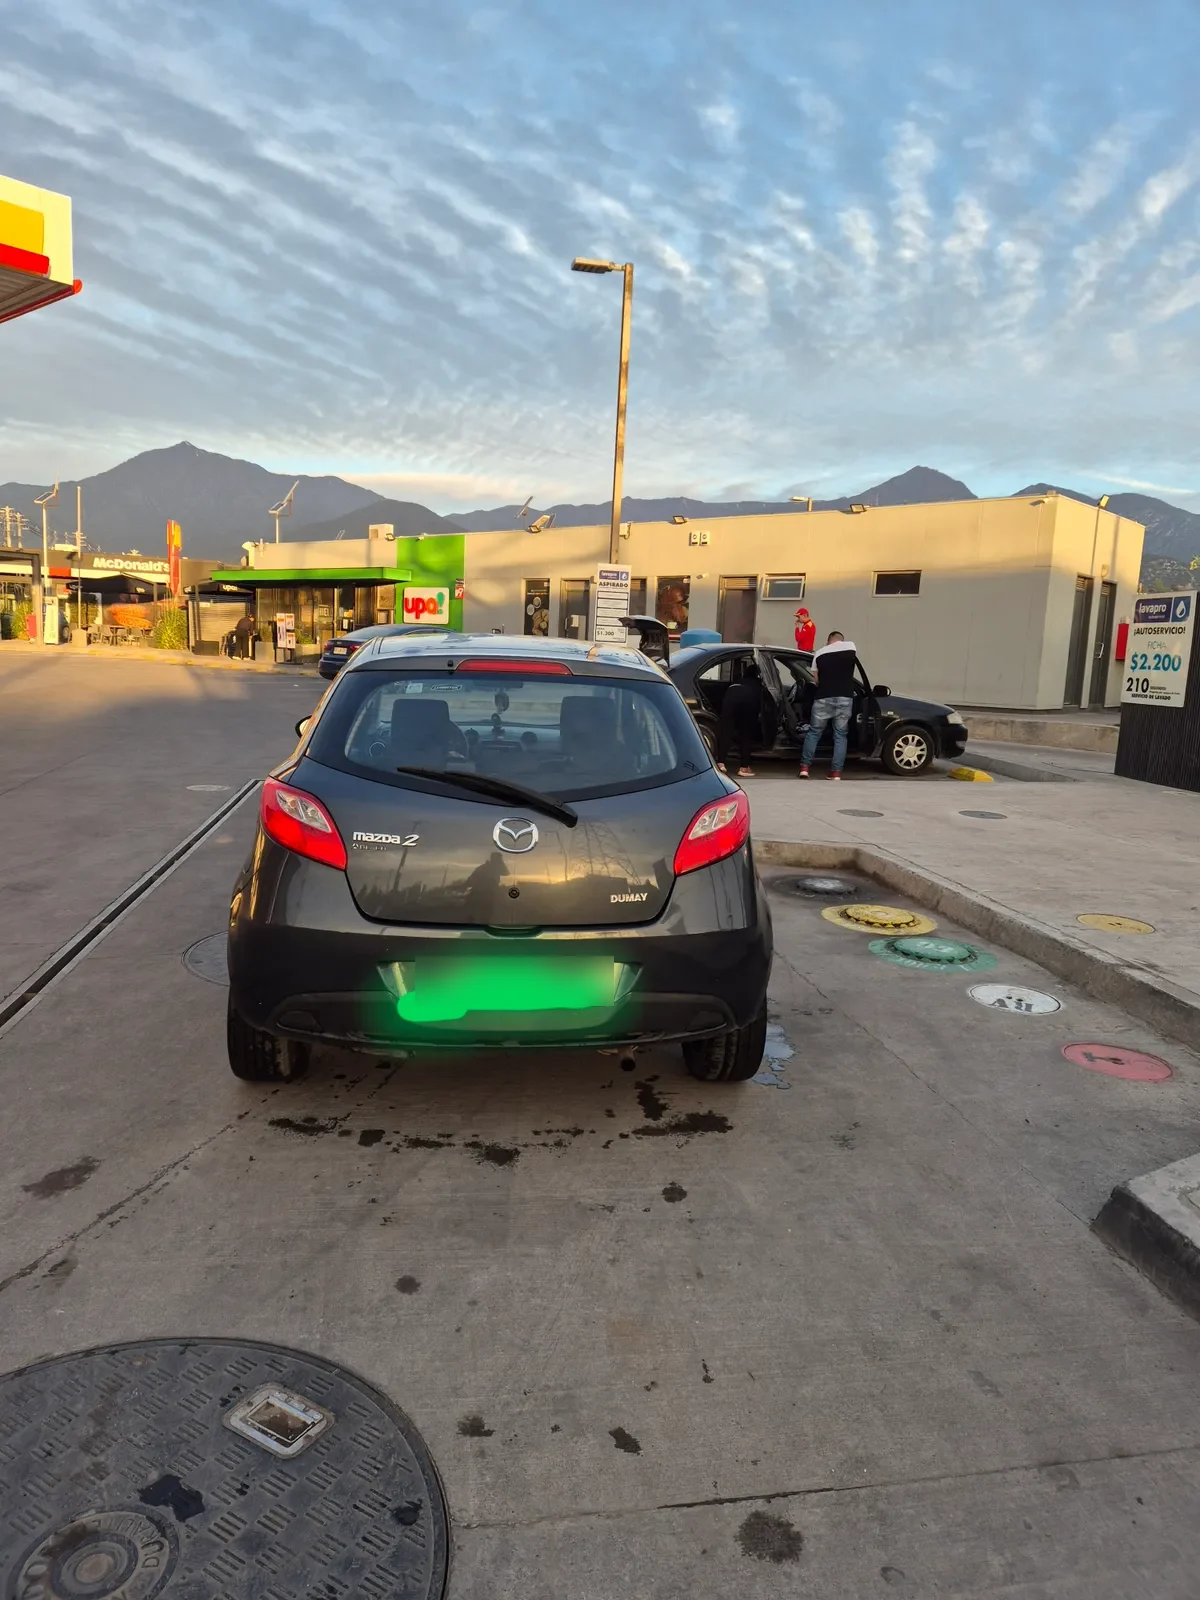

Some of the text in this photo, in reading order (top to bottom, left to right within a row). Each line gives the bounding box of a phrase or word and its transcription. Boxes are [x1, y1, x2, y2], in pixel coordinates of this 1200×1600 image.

[93, 557, 170, 572] McDonald's
[404, 592, 445, 619] upa!
[1139, 602, 1167, 615] lavapro
[1133, 626, 1186, 636] ¡AUTOSERVICIO!
[1130, 652, 1182, 672] $2.200
[1126, 676, 1150, 693] 210
[610, 892, 648, 903] DUMAY
